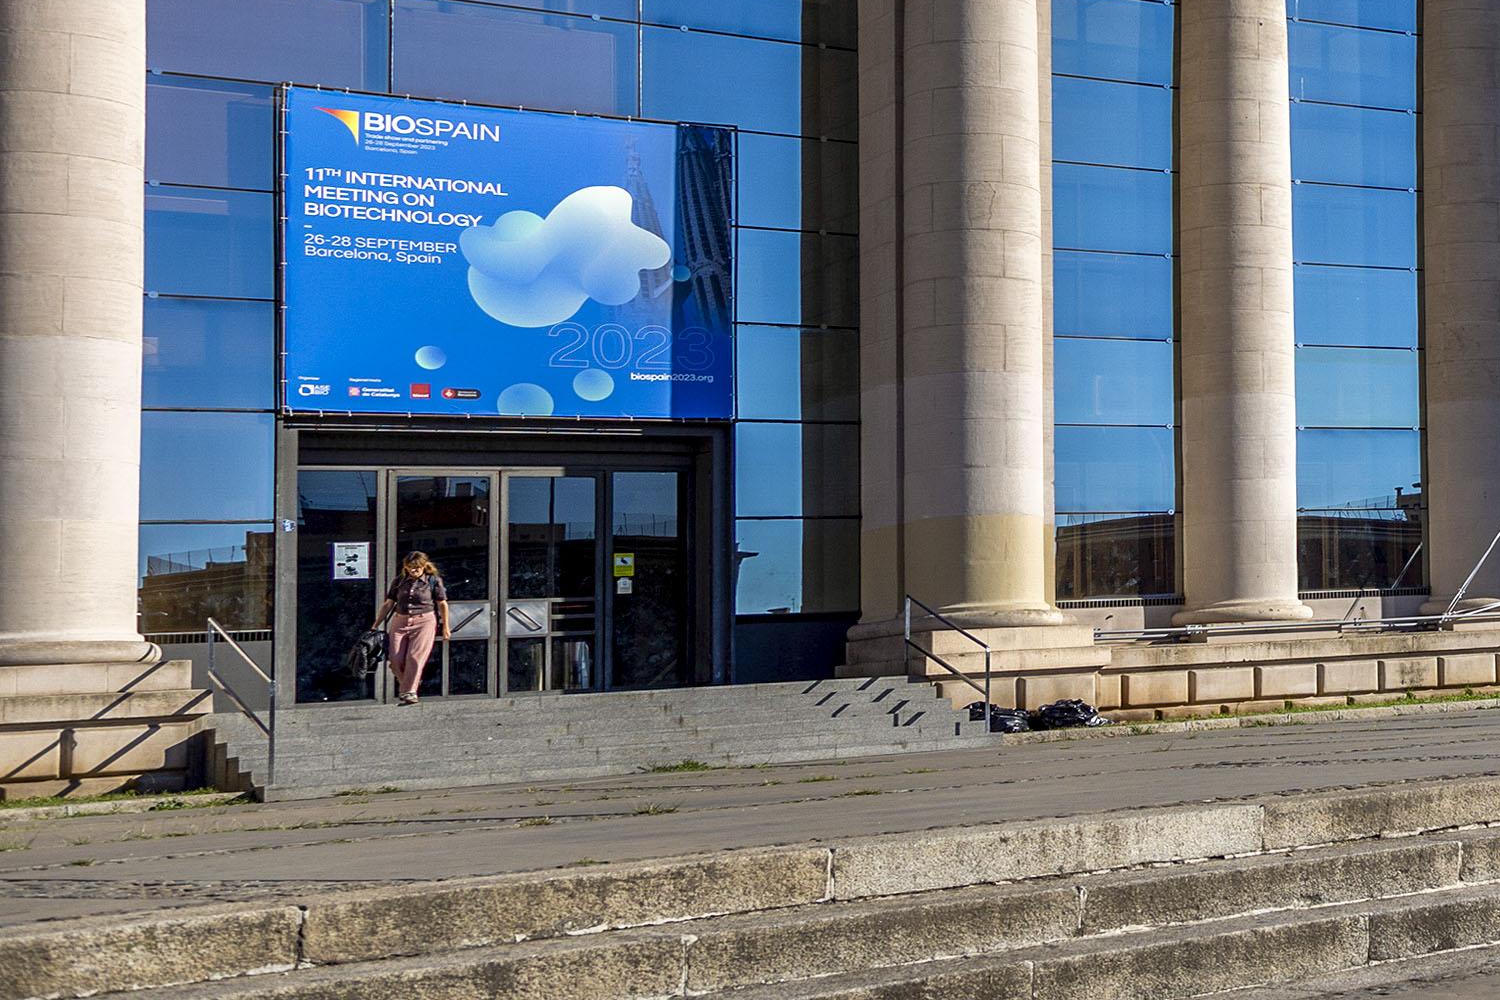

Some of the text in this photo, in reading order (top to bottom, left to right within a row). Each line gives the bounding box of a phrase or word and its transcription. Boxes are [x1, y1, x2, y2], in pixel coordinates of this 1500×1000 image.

[364, 112, 500, 142] BIOSPAIN
[305, 167, 508, 196] 11TH INTERNATIONAL
[304, 184, 434, 208] MEETING ON
[304, 202, 482, 228] BIOTECHNOLOGY
[304, 234, 458, 254] 26-28 SEPTEMBER
[305, 246, 441, 264] Barcelona, Spain
[548, 322, 716, 371] 2023
[630, 372, 714, 383] biospain2023.org
